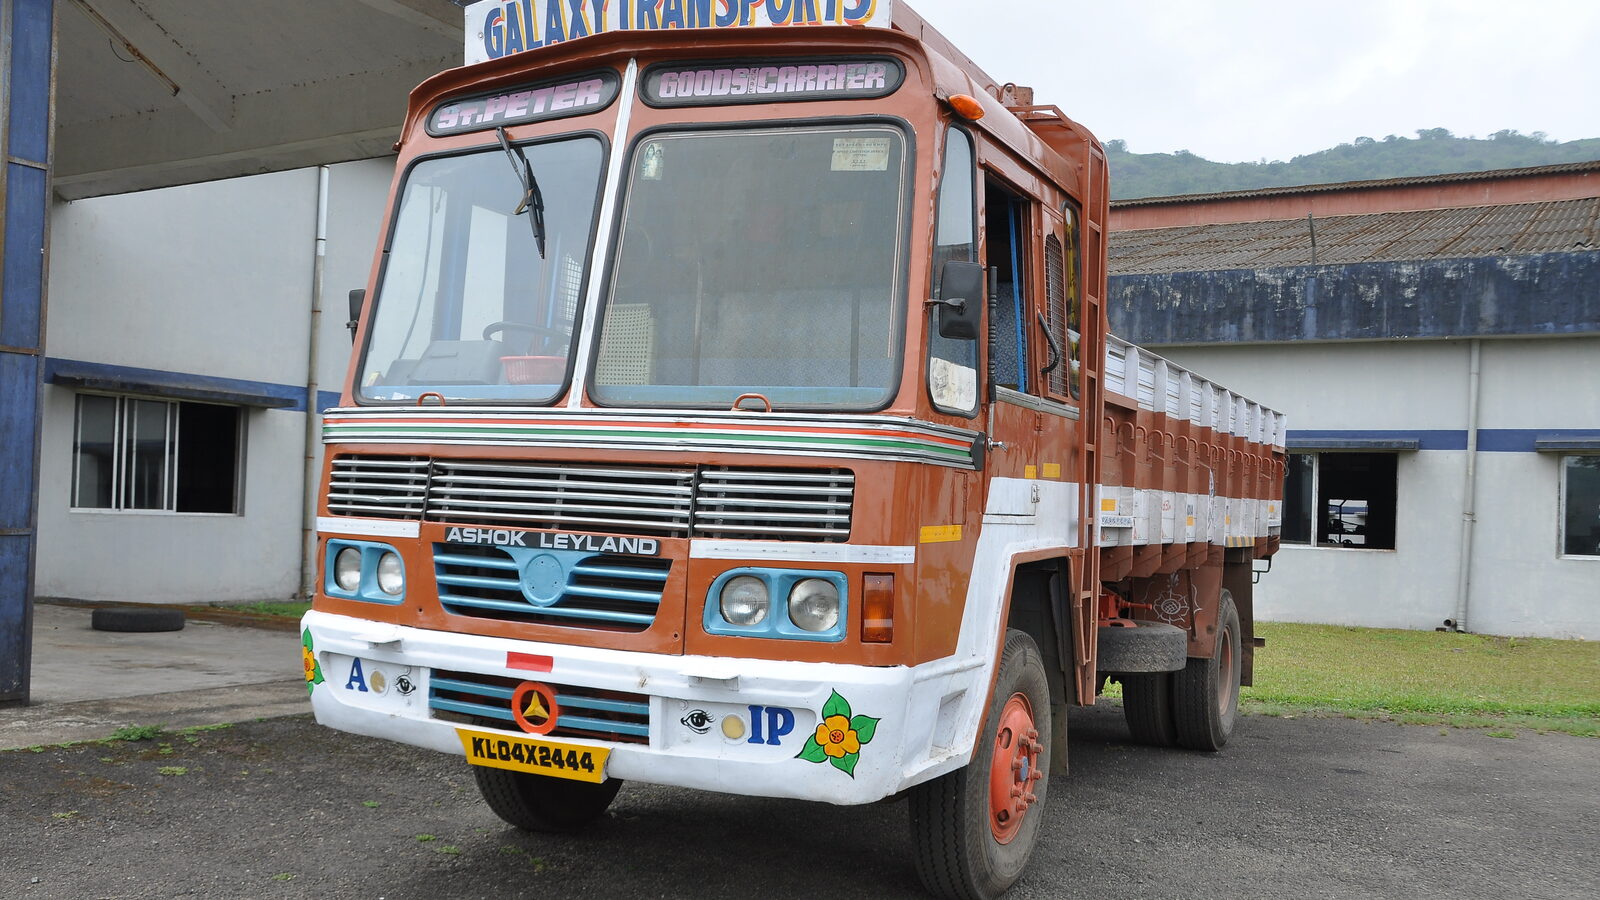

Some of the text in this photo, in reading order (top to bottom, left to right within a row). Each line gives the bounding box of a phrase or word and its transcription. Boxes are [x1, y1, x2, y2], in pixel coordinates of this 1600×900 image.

[484, 0, 608, 59] GALAXY
[659, 68, 749, 98] GOODS
[756, 64, 886, 94] CARRIER
[446, 527, 658, 555] ASHOK LEYLAND
[345, 657, 795, 745] A IP
[472, 737, 594, 773] KL04X2444
